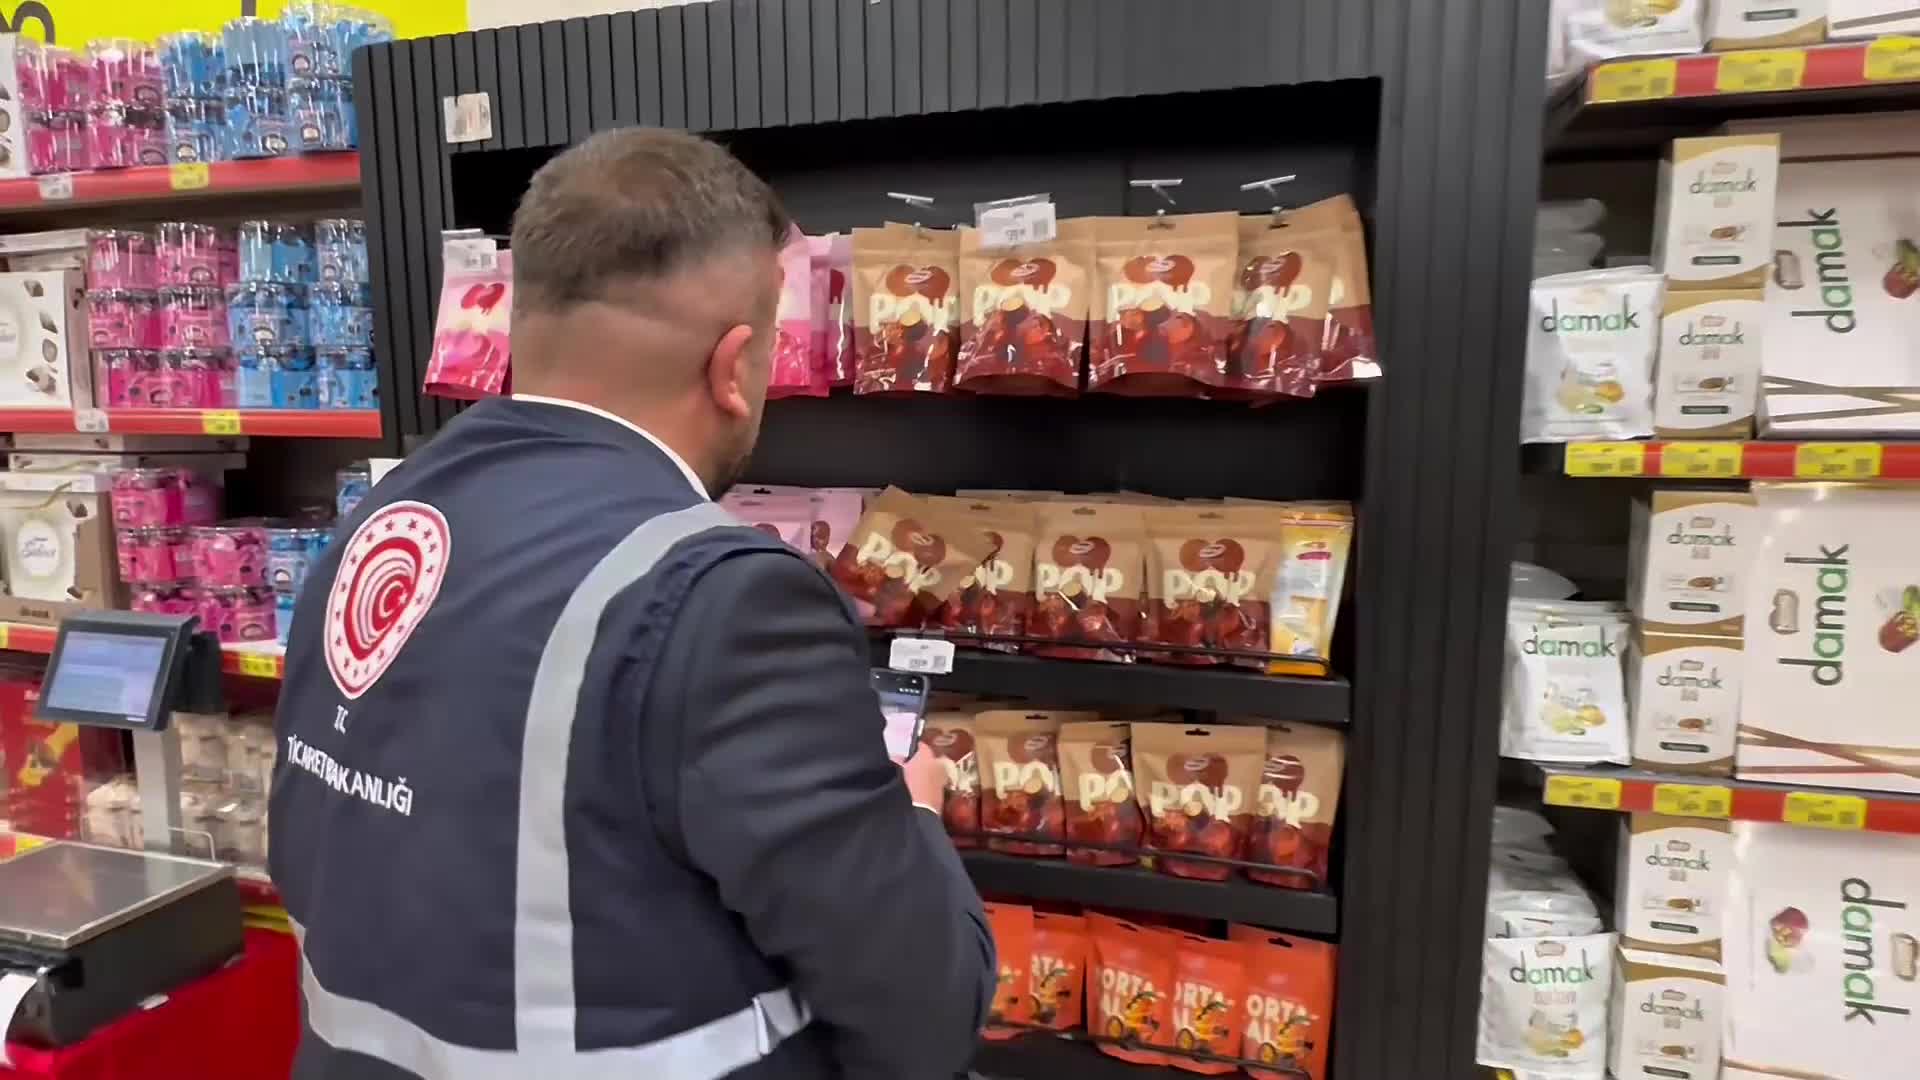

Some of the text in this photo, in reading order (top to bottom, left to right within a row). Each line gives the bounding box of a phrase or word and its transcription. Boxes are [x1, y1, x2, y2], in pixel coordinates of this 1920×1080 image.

[1690, 168, 1757, 194] damak
[1777, 207, 1856, 333] damak
[1541, 294, 1641, 334] damak
[1679, 321, 1745, 346] damak
[1666, 522, 1737, 546] damak
[1777, 543, 1850, 686] damak
[1522, 625, 1617, 658] damak
[1655, 665, 1723, 691] damak
[1645, 847, 1711, 872] damak
[1840, 877, 1911, 1025] damak
[1509, 949, 1596, 985] damak
[1640, 992, 1705, 1021] damak
